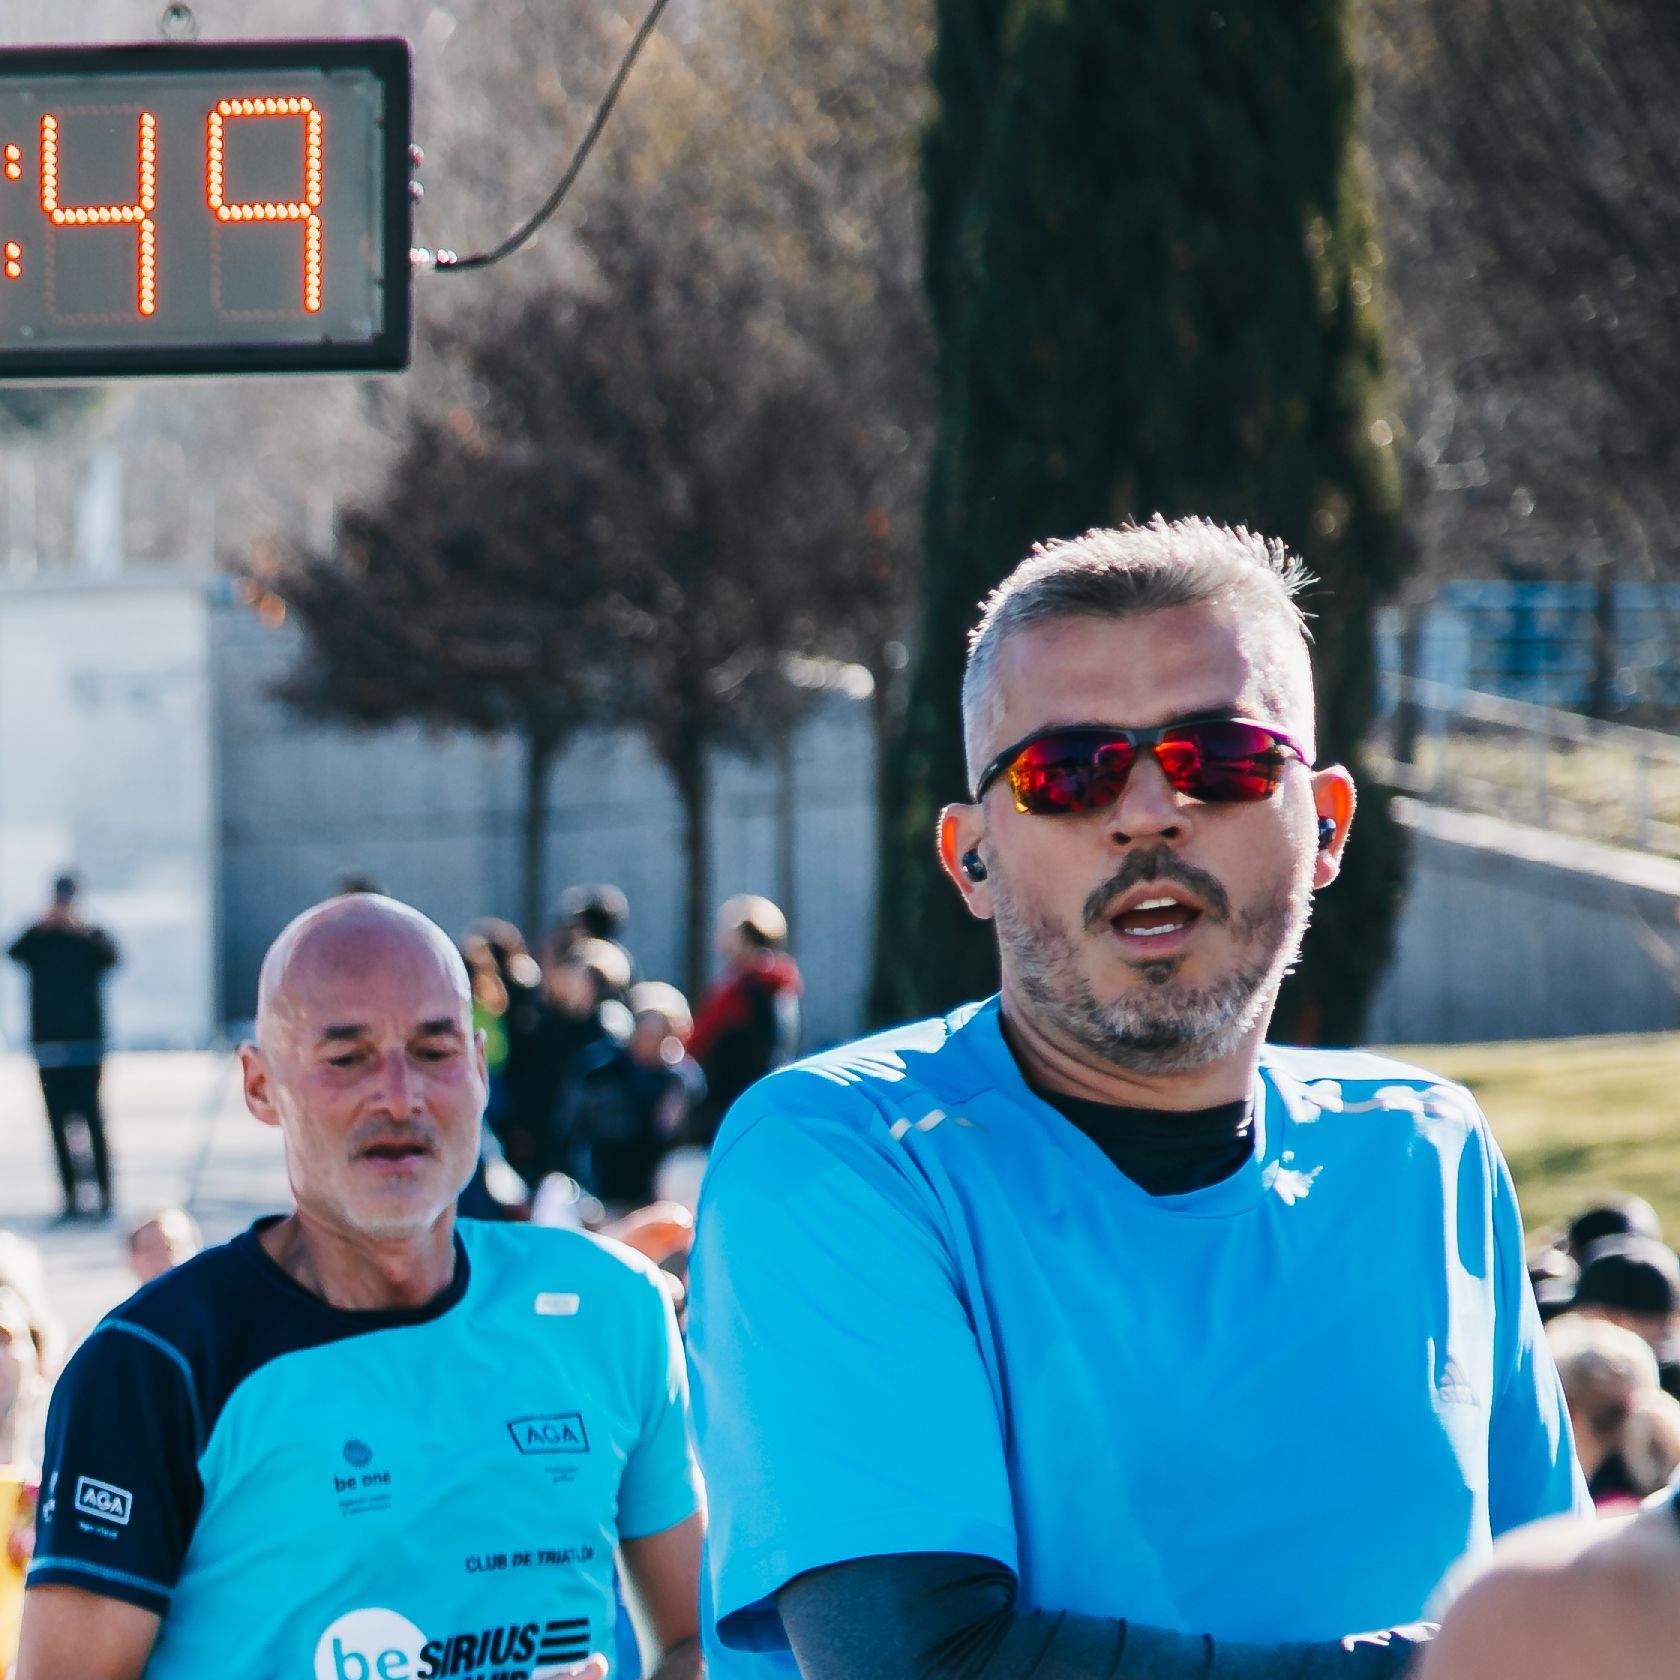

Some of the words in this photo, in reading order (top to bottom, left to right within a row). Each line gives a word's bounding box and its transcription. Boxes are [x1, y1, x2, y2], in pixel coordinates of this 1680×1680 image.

[83, 1487, 124, 1515] AGA
[465, 1554, 508, 1573] CLUB
[512, 1553, 532, 1569] DE
[417, 1622, 538, 1680] SIRIUS
